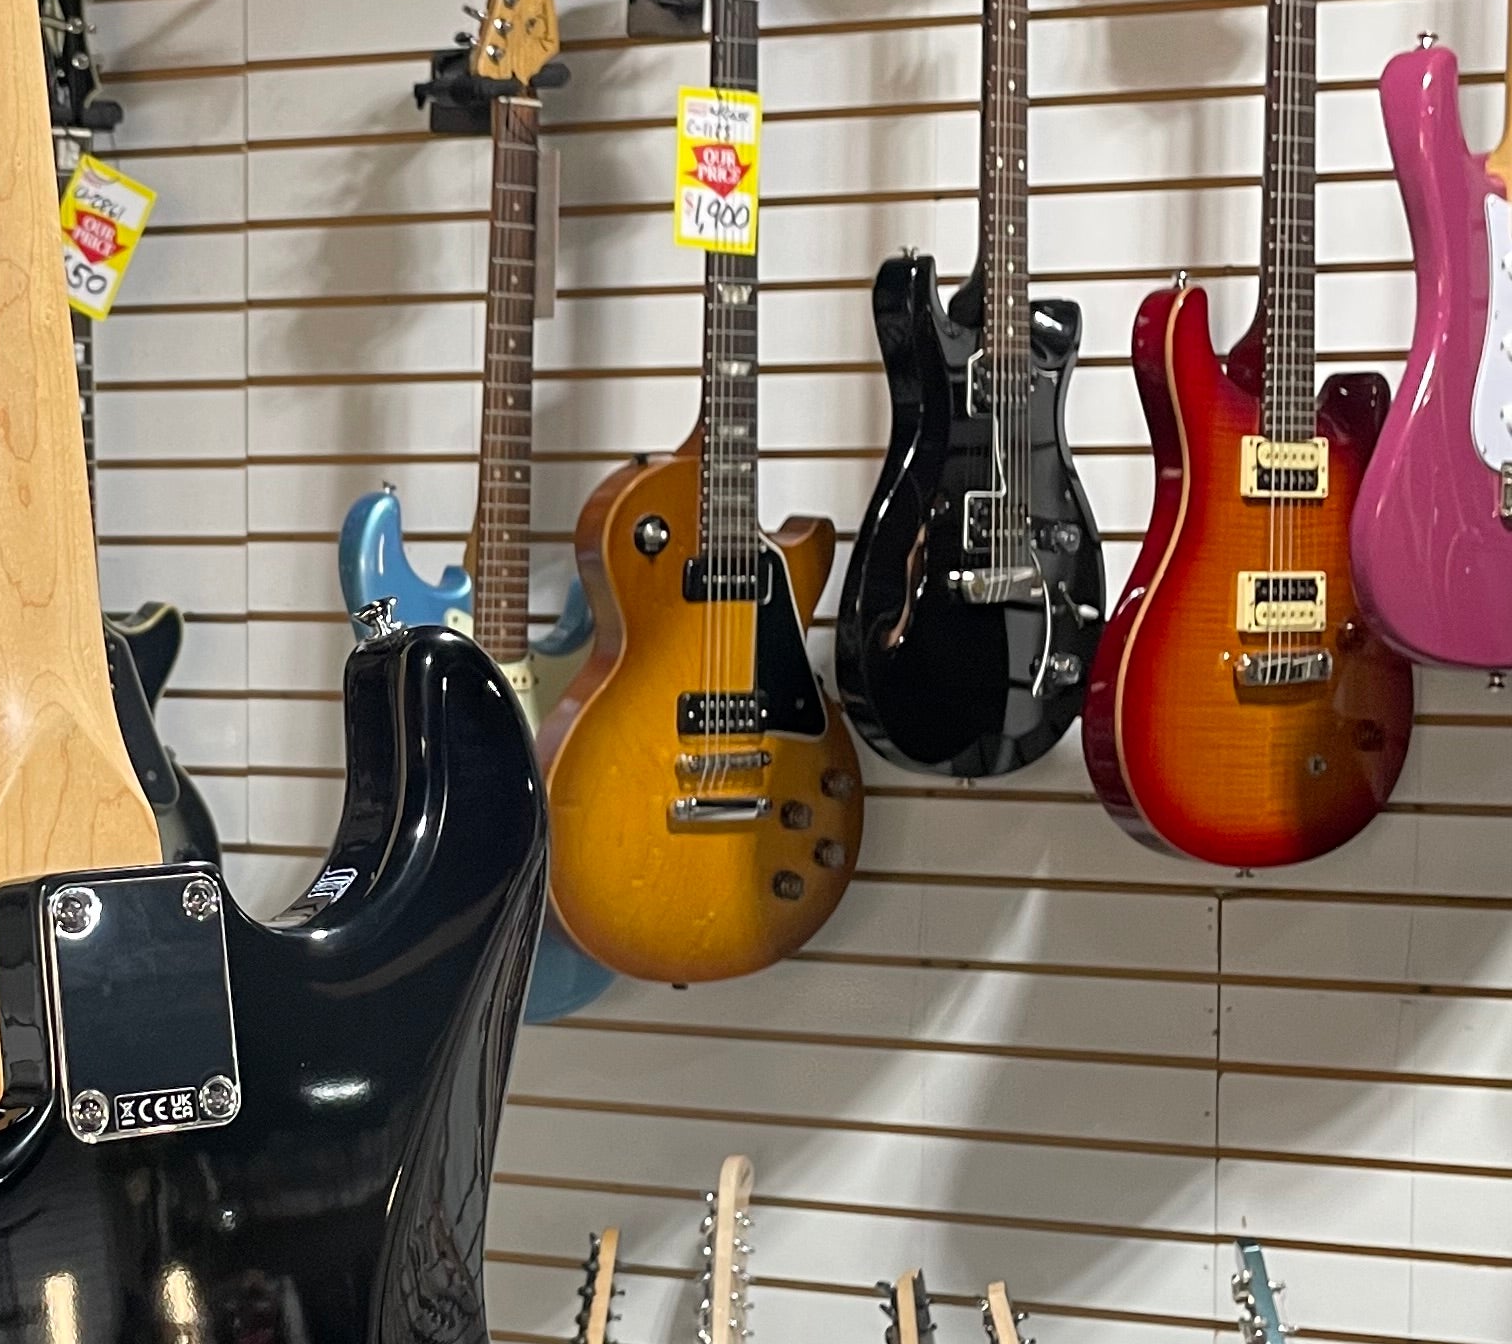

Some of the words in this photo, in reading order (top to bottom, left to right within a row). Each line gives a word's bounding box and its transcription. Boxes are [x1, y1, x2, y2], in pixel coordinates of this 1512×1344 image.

[702, 147, 736, 167] OUR
[697, 162, 742, 185] PRICE
[82, 214, 116, 240] OUR
[71, 226, 118, 257] PRICE
[64, 255, 107, 295] 50
[138, 1096, 169, 1123] CE
[170, 1093, 192, 1107] UK
[171, 1106, 194, 1120] CA
